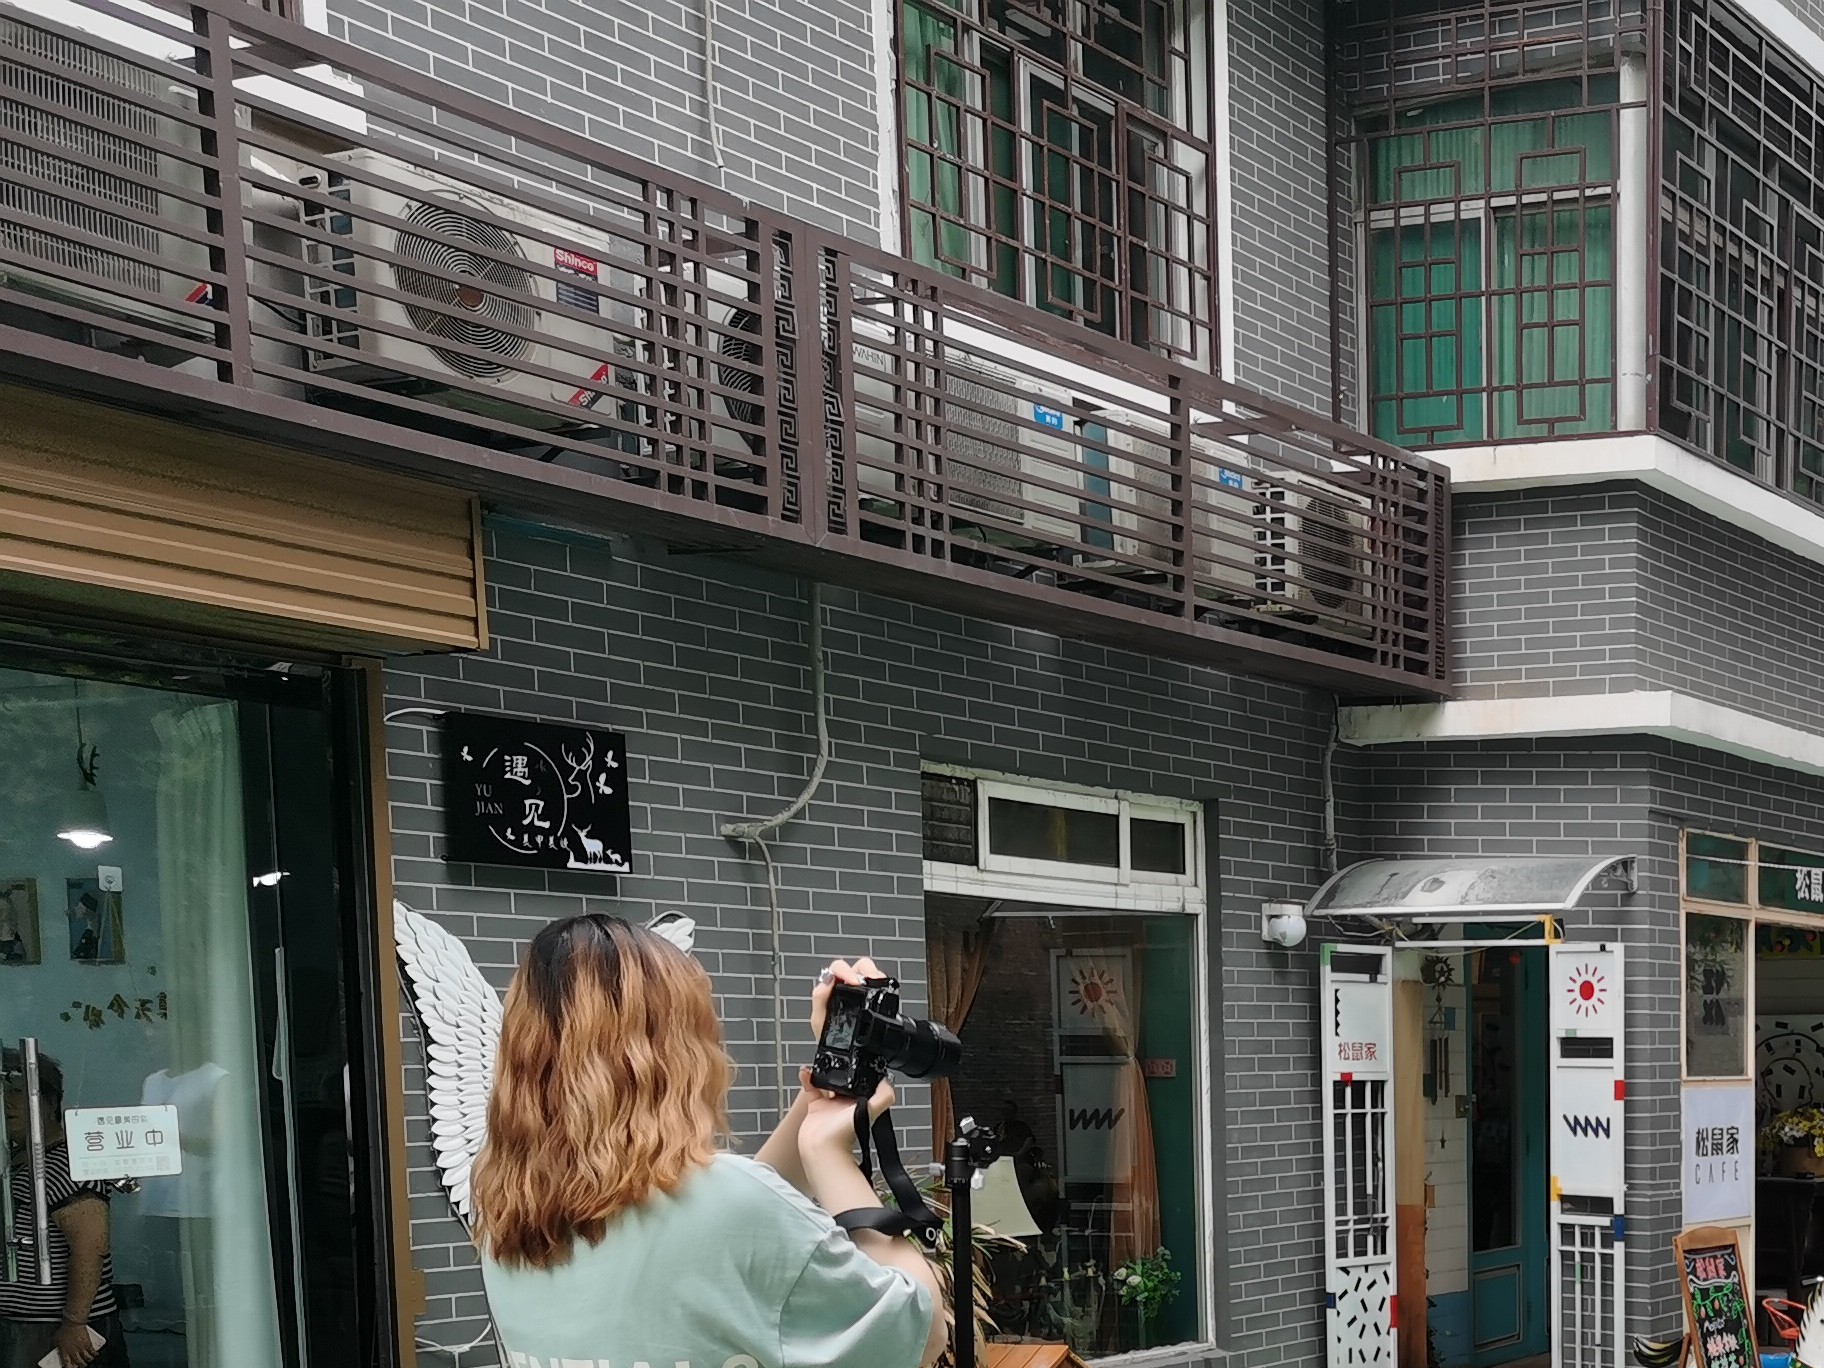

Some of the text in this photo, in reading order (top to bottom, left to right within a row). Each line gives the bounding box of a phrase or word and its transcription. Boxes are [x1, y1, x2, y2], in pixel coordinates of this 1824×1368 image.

[555, 248, 595, 272] Shinco
[474, 783, 492, 797] YU
[504, 755, 550, 829] 遇见
[474, 801, 504, 816] JIAN
[1338, 1041, 1377, 1061] 松鼠家
[84, 1128, 164, 1152] 营业中
[1695, 1126, 1740, 1157] 松鼠家
[1694, 1160, 1740, 1185] CAFE
